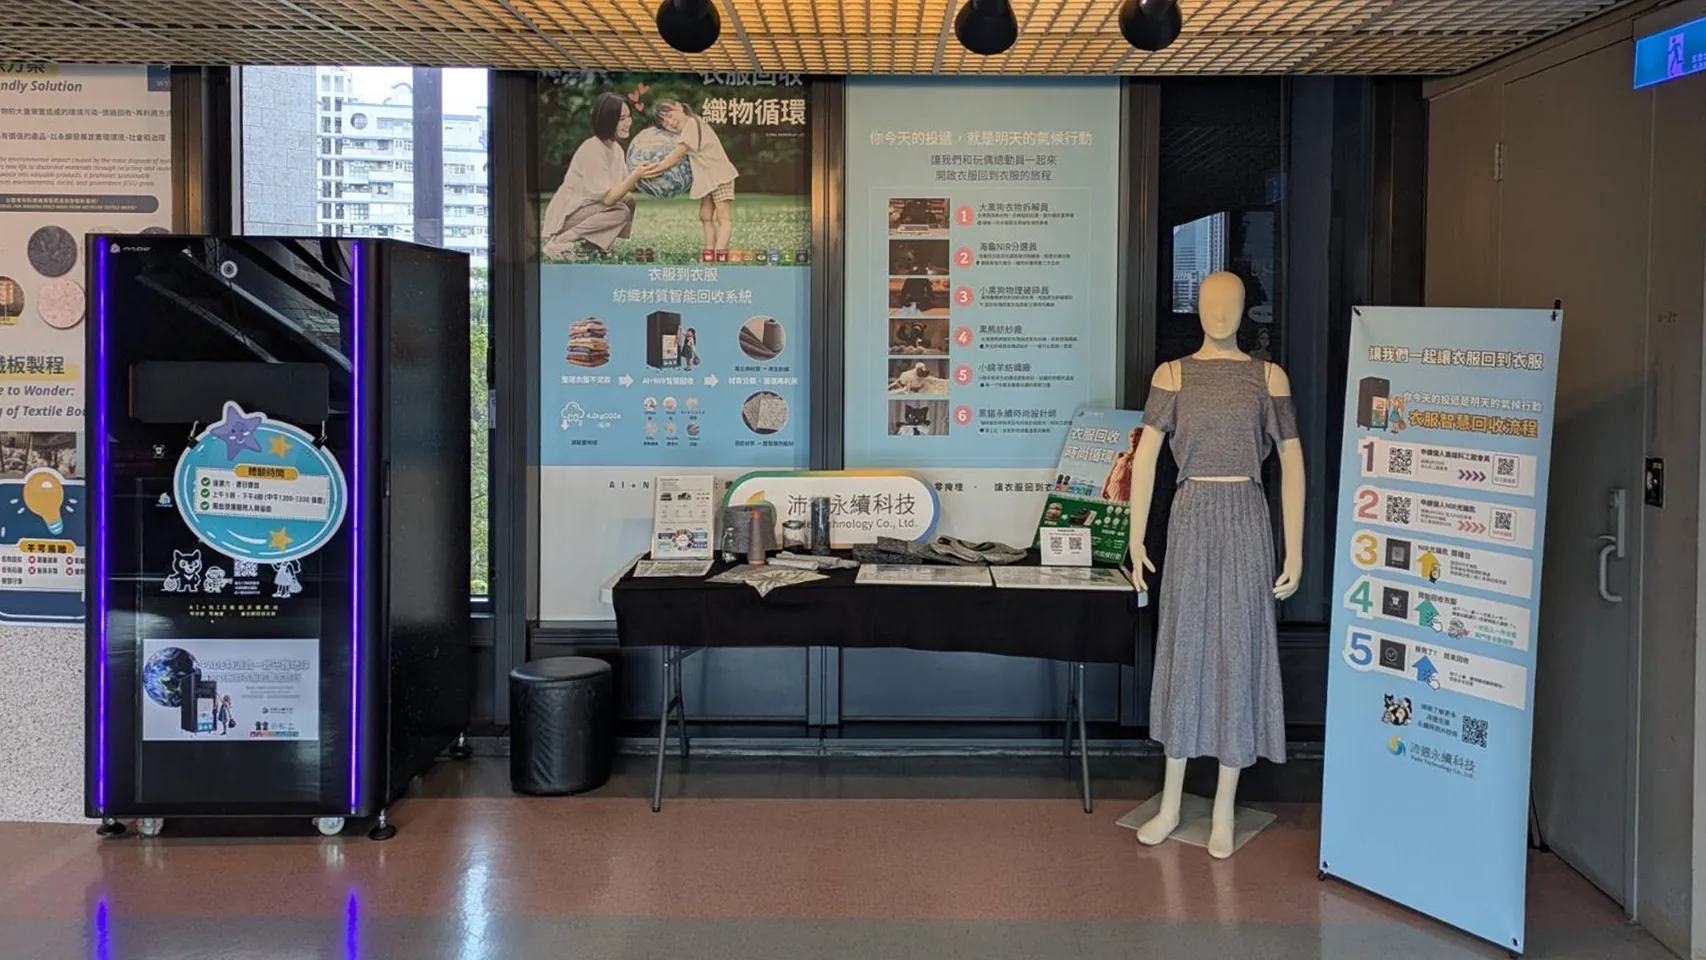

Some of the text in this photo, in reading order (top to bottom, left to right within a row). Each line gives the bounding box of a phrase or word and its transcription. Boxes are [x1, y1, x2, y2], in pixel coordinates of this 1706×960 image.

[31, 80, 82, 93] Solution
[702, 98, 806, 126] 織物循環
[960, 211, 967, 221] 1
[959, 253, 968, 264] 2
[648, 267, 718, 283] 衣服到衣服
[612, 288, 753, 305] 紡織材質智能回收系統
[959, 291, 968, 302] 3
[958, 331, 968, 342] 4
[1368, 346, 1544, 370] 讓我們一起讓衣服回到衣服
[959, 369, 968, 381] 5
[11, 386, 20, 397] to
[24, 386, 76, 397] Wonder:
[6, 405, 19, 420] of
[23, 405, 64, 417] Textile
[958, 410, 967, 421] 6
[1408, 410, 1539, 438] 衣服智慧回收流程
[1070, 427, 1121, 445] 衣服回收
[1362, 441, 1375, 472] 1
[788, 493, 915, 517] 沛永續科技
[1358, 490, 1379, 520] 2
[876, 518, 896, 530] Co.,
[898, 518, 918, 528] Ltd.
[1355, 533, 1378, 566] 3
[1349, 580, 1373, 613] 4
[1349, 632, 1373, 666] 5
